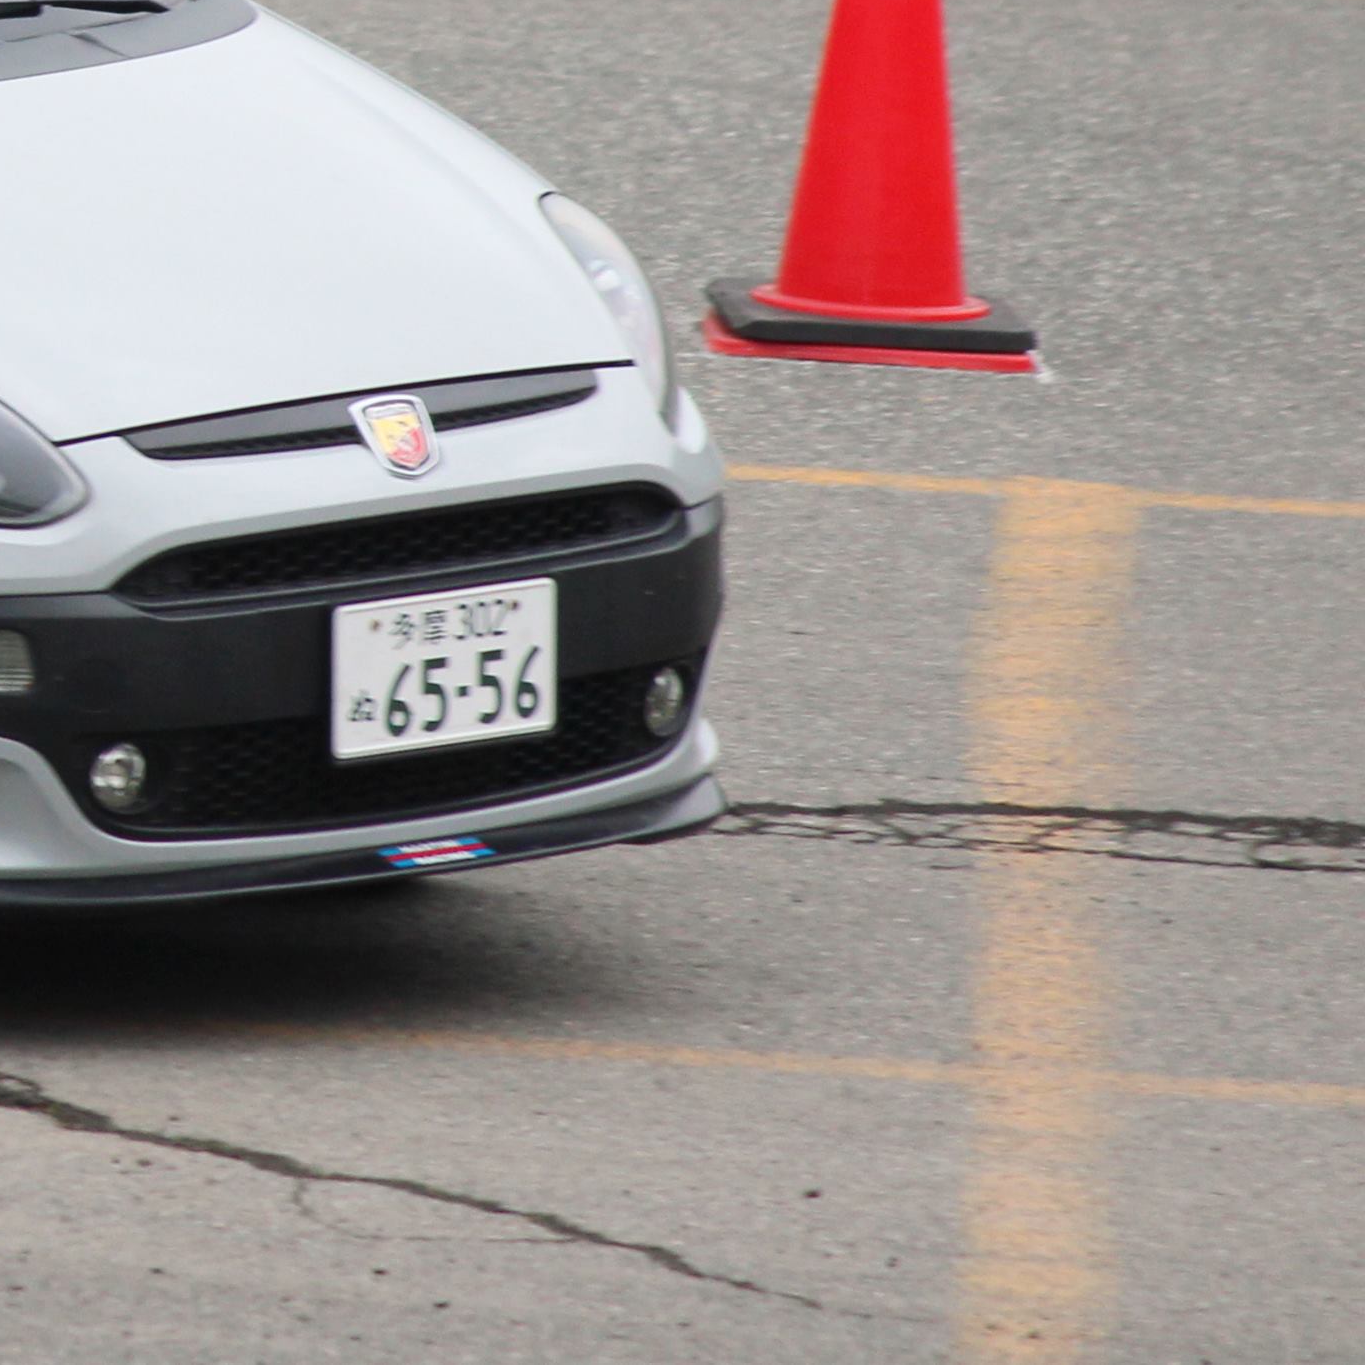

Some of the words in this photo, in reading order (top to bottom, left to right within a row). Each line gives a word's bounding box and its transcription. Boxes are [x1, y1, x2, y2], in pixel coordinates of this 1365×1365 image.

[387, 609, 447, 650] 多摩
[453, 598, 507, 640] 302
[386, 645, 539, 737] 65-56
